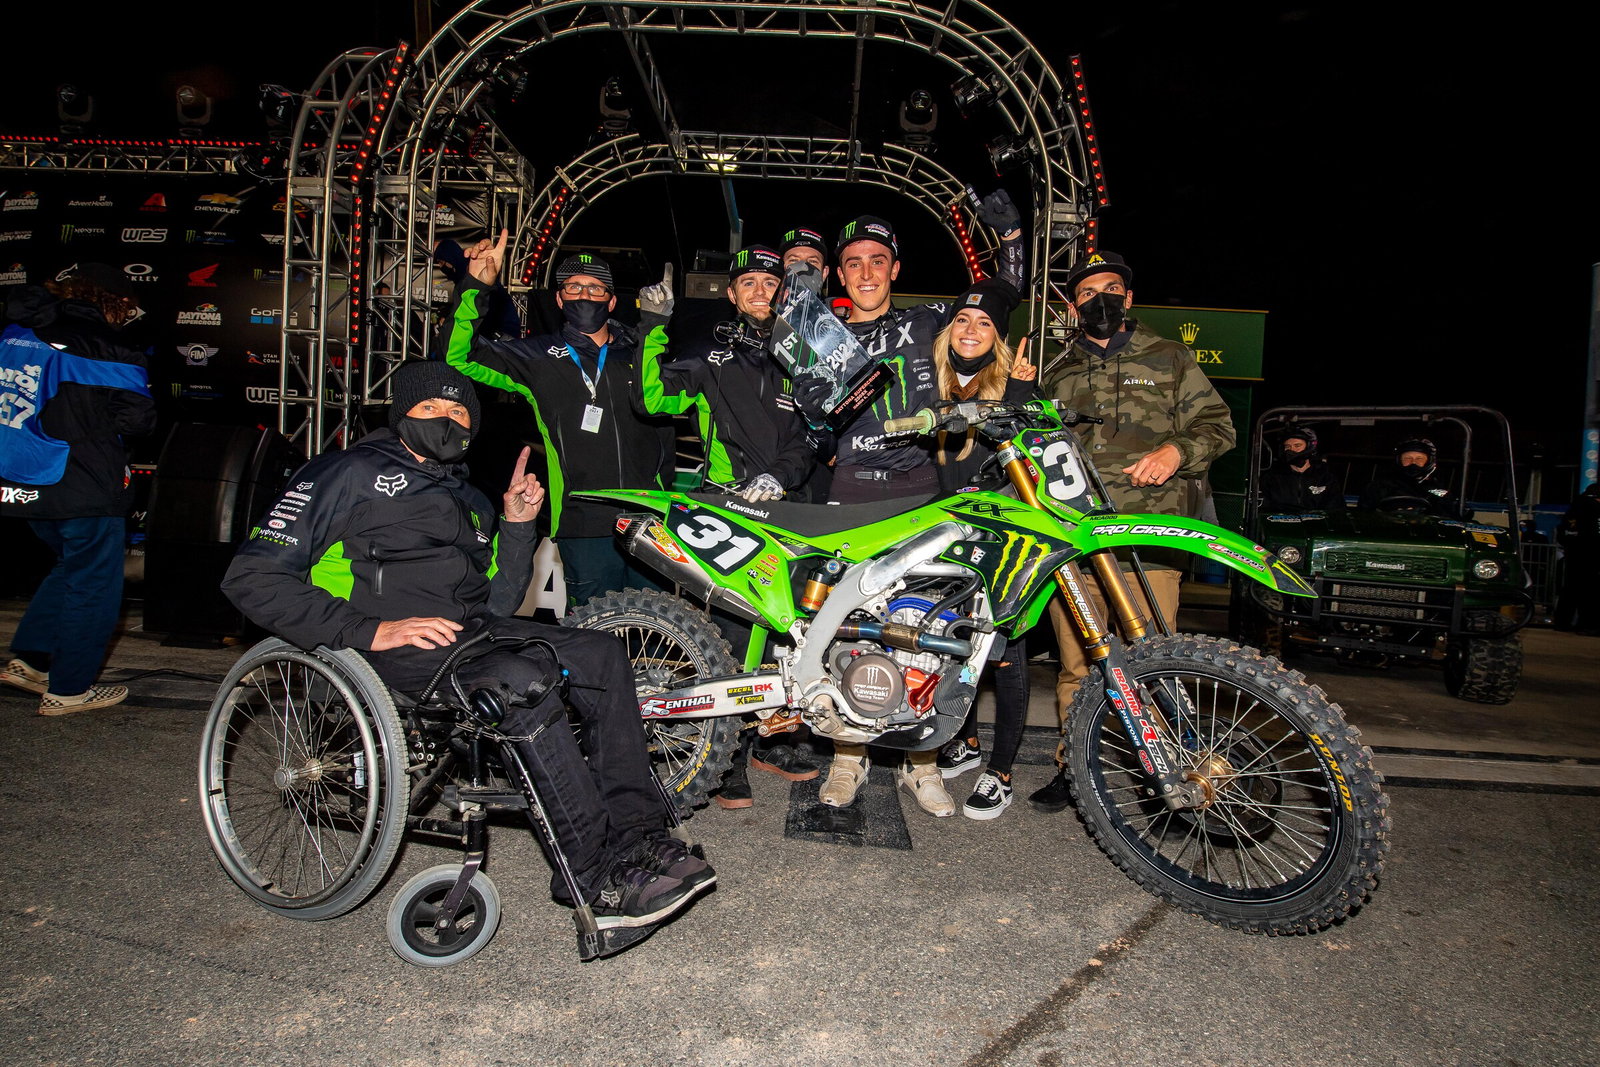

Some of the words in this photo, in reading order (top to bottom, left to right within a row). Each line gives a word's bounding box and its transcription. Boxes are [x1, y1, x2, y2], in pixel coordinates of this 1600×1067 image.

[194, 205, 240, 214] CHEVROLET
[121, 228, 168, 243] WPS
[178, 311, 222, 321] DAYTONA
[190, 350, 206, 360] FIM
[1123, 378, 1156, 386] ARMA
[834, 395, 855, 415] DAYTONA
[853, 370, 881, 397] SUPERCROSS
[725, 500, 770, 519] Kawasaki
[259, 529, 299, 546] MONSTER
[1091, 524, 1128, 536] PRO
[1129, 525, 1218, 541] CIRCUIT
[676, 515, 760, 570] 31
[1365, 561, 1406, 571] Kawasaki
[1067, 579, 1100, 634] CIRCUIT
[727, 686, 753, 694] EXCEL
[754, 683, 773, 693] RK
[854, 687, 889, 698] Kawasaki
[1112, 667, 1141, 717] BRAKING
[1120, 709, 1141, 747] PISTONS
[675, 743, 712, 793] DUNLOP
[1308, 733, 1353, 812] DUNLOP
